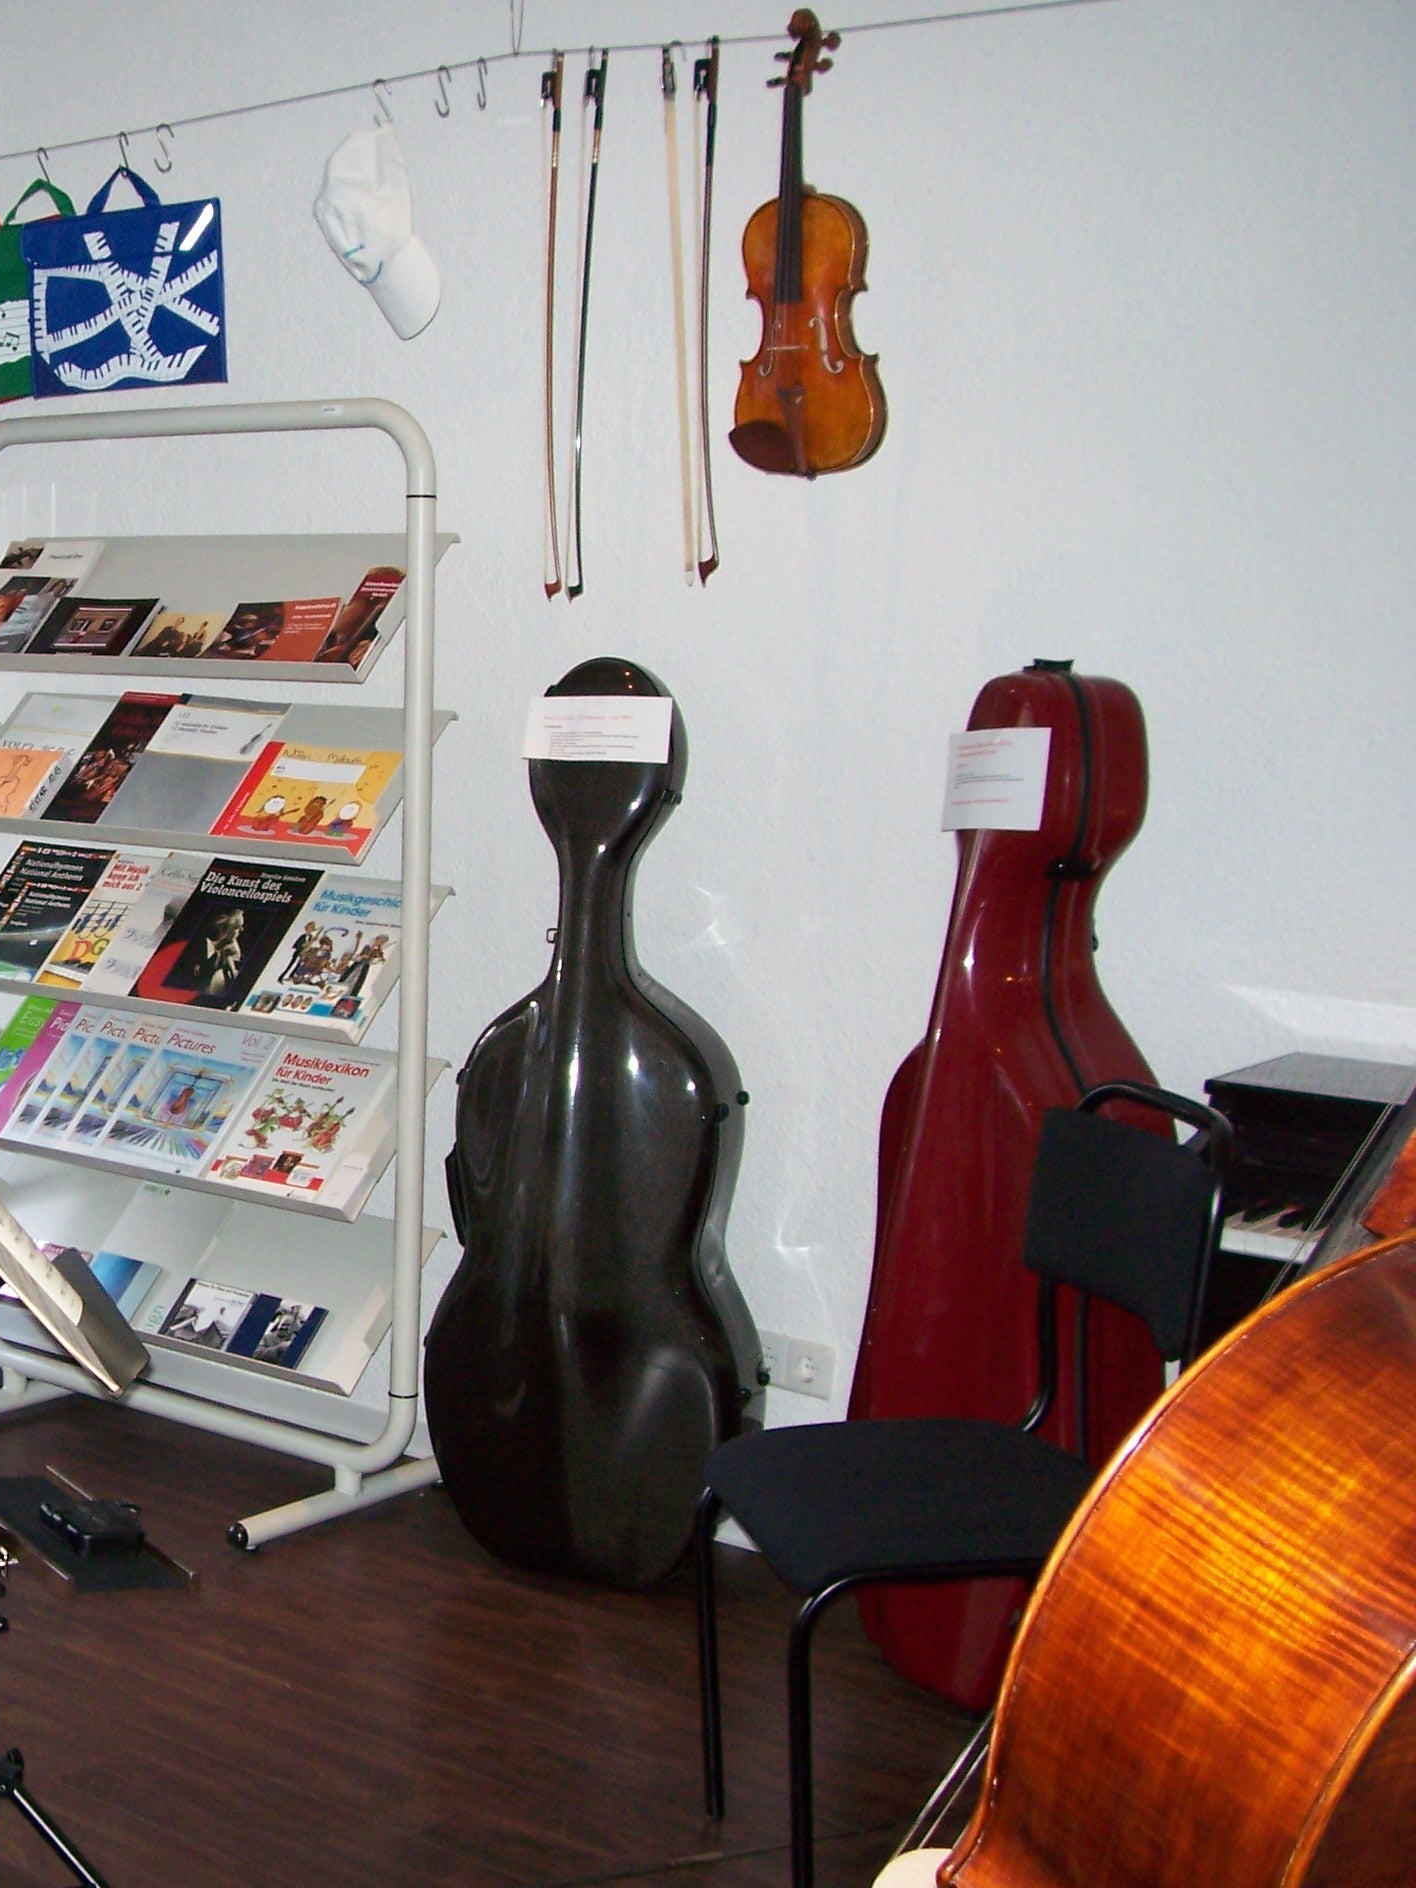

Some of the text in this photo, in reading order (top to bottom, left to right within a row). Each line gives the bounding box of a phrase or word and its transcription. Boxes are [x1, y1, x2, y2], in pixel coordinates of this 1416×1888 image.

[127, 864, 150, 875] Musik
[204, 871, 283, 891] Die Kunst des
[200, 880, 293, 904] Violoncellospiels
[313, 901, 372, 918] für Kinder
[166, 1032, 217, 1055] Pictures
[275, 1065, 293, 1078] für
[293, 1069, 333, 1085] Kinder
[283, 1052, 370, 1079] Musiklexikon
